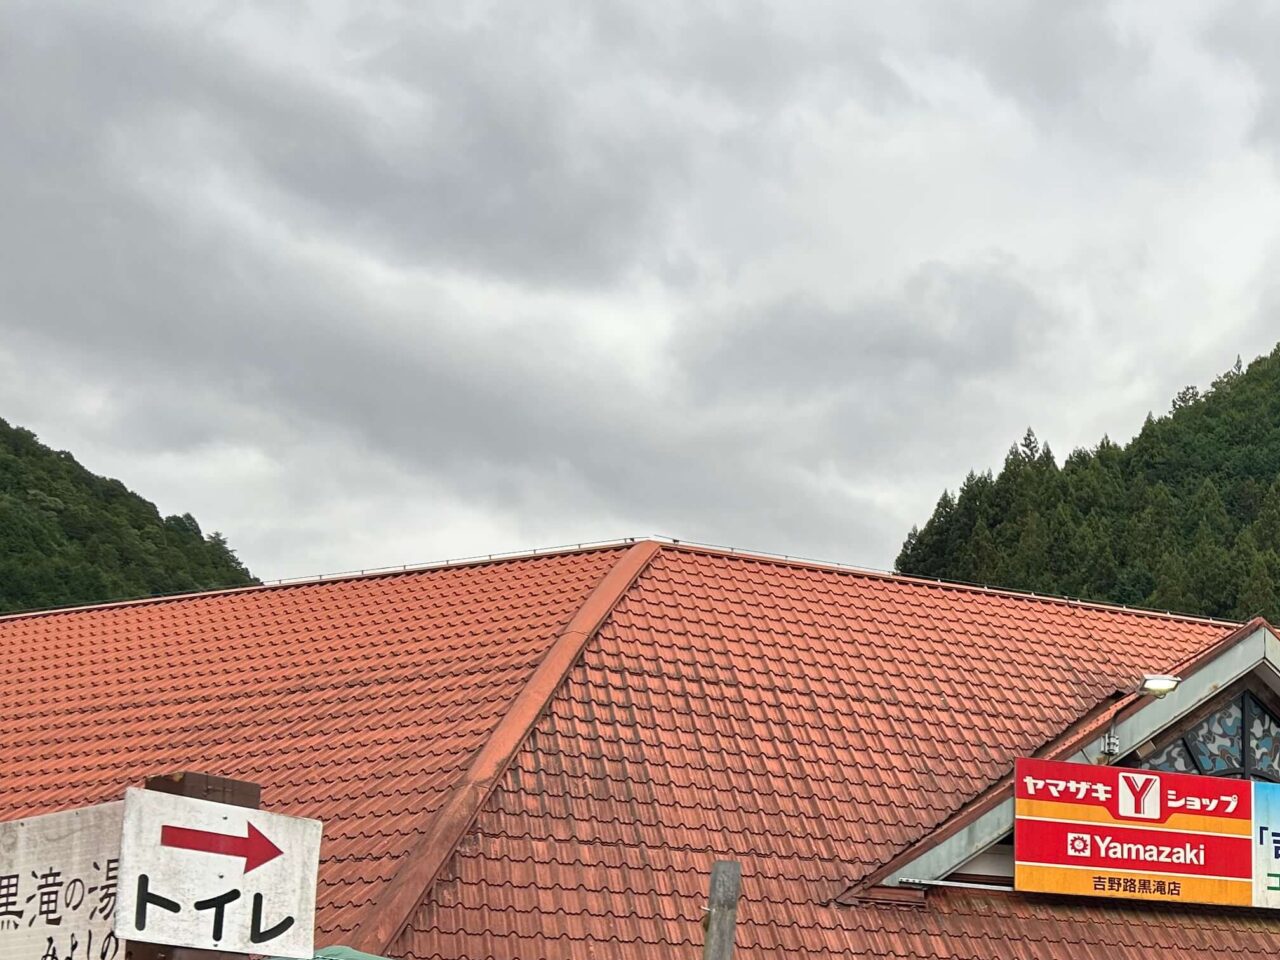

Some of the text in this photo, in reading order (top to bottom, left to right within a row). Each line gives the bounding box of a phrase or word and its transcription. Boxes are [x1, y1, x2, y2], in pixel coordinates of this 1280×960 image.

[1023, 775, 1238, 815] ヤマザキ Y ショップ
[1094, 835, 1204, 865] Yamazaki
[1092, 875, 1181, 896] 吉野路黒滝店
[135, 873, 295, 944] トイレ
